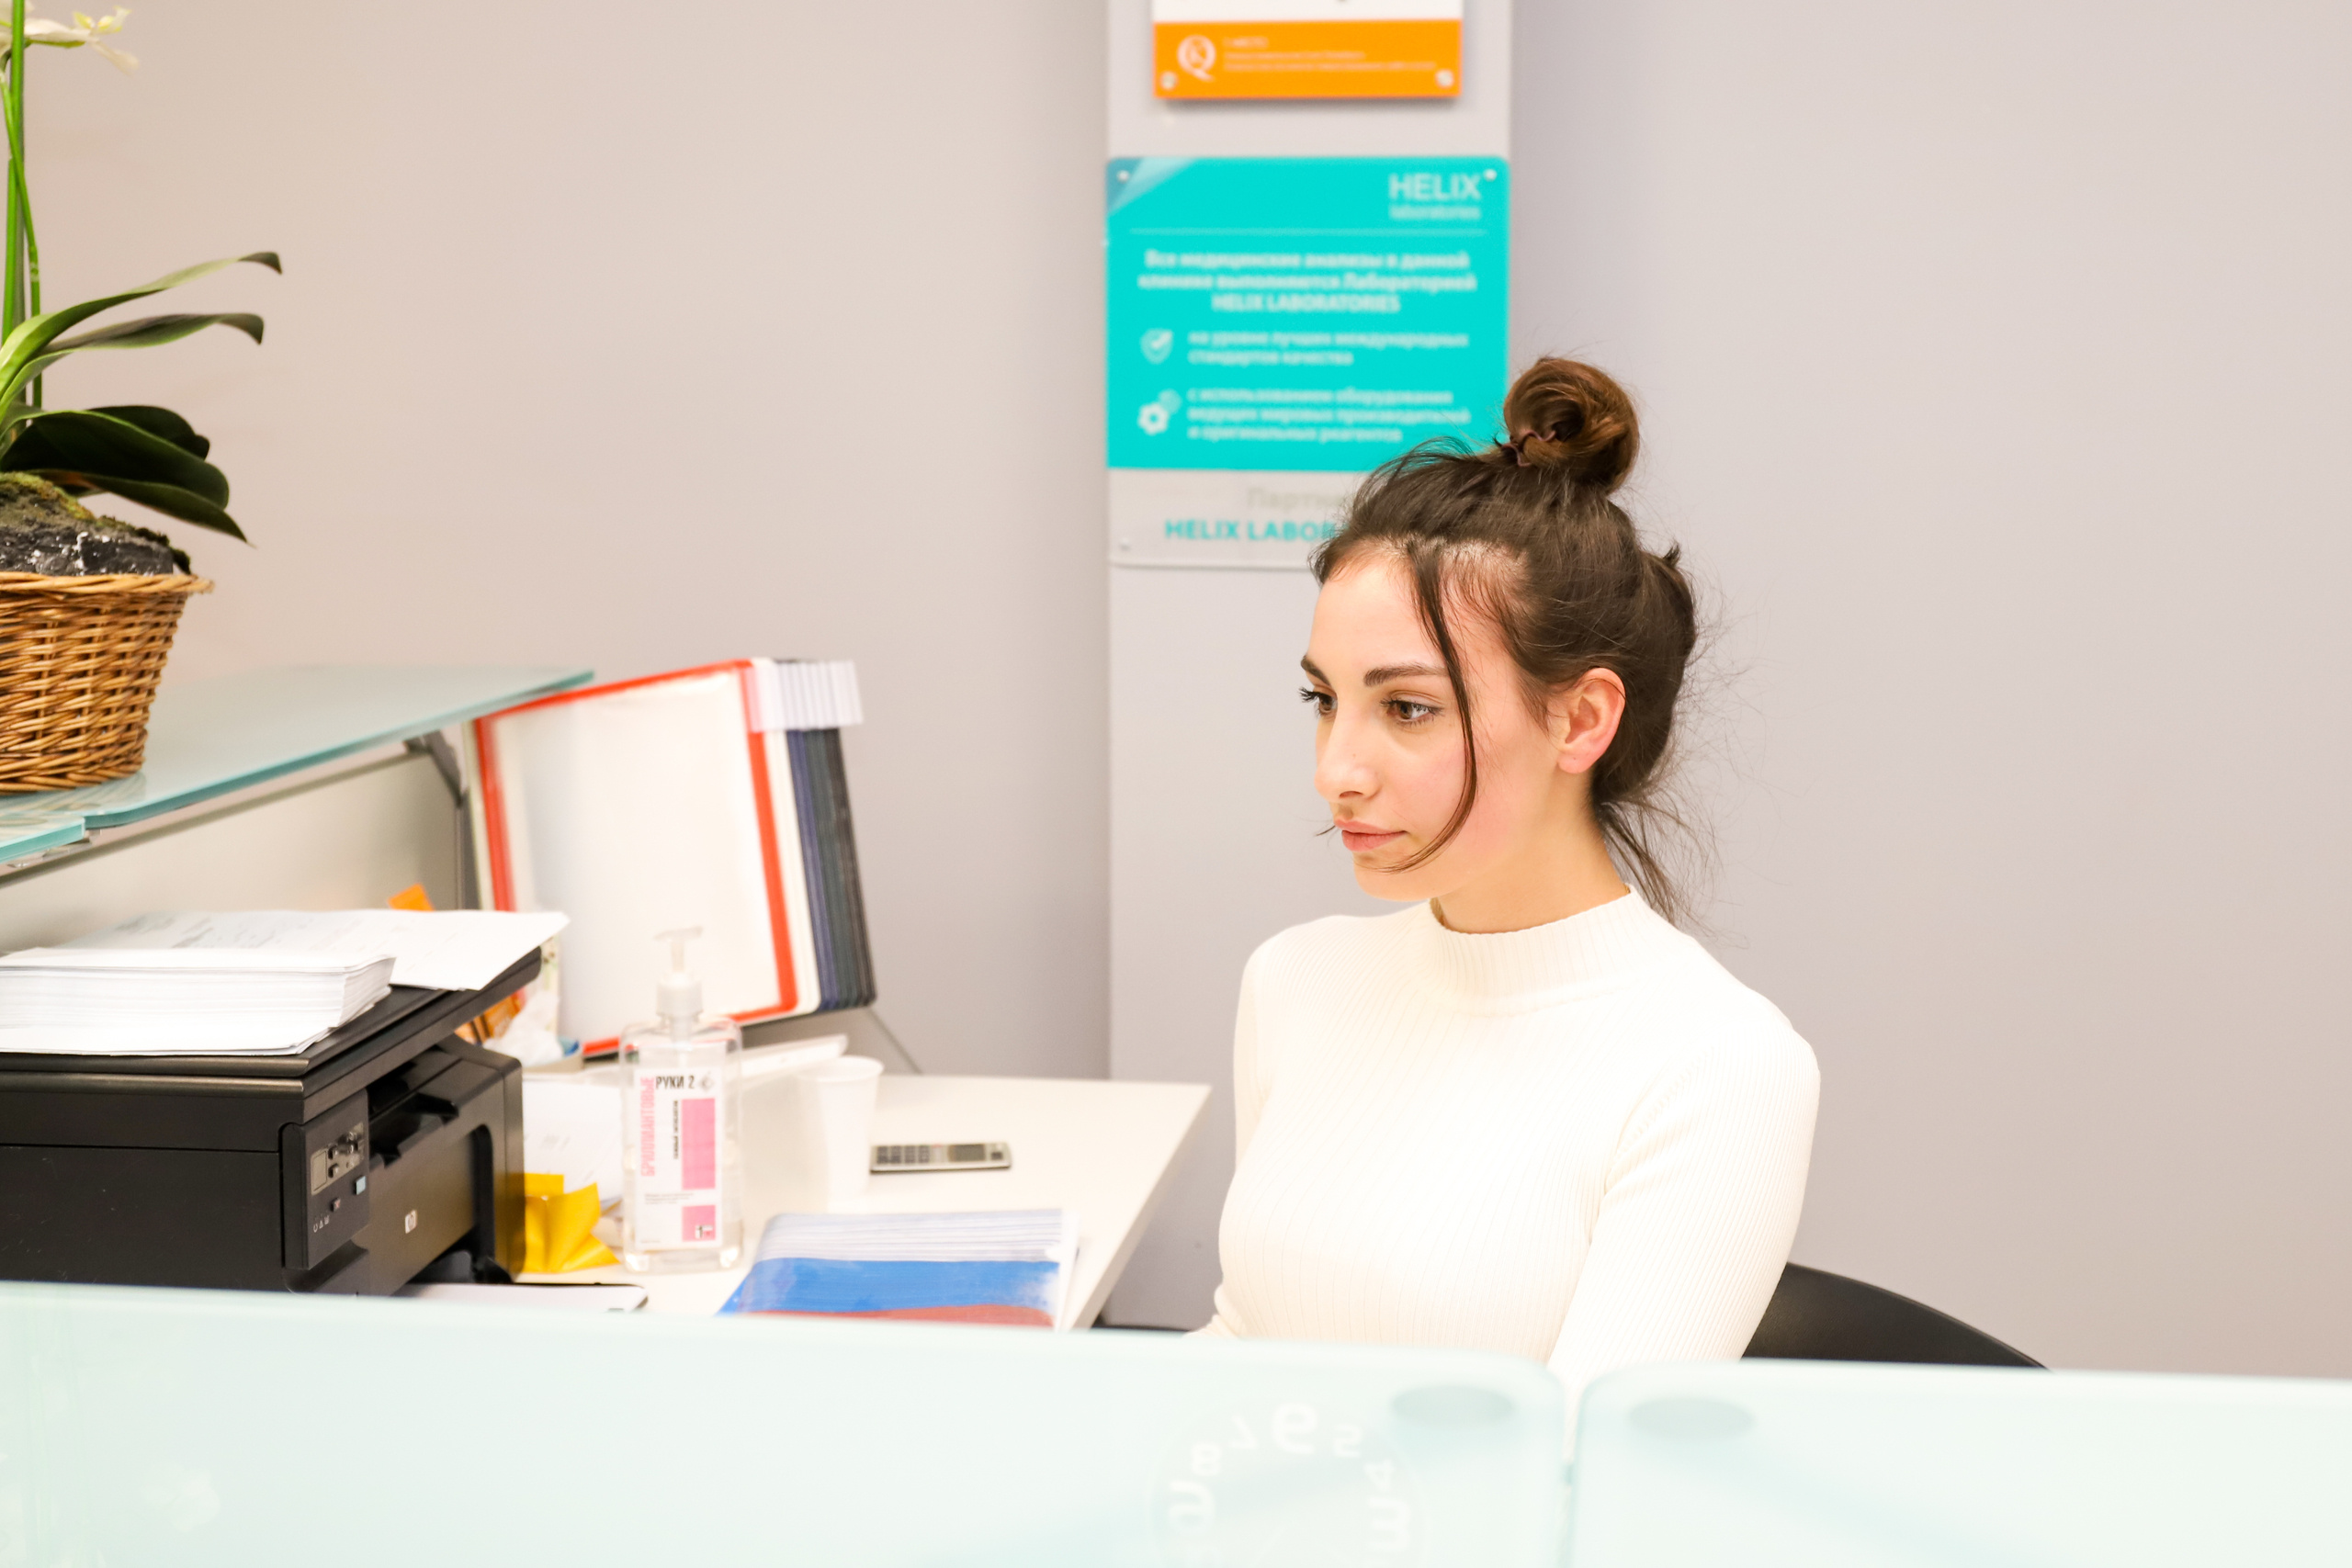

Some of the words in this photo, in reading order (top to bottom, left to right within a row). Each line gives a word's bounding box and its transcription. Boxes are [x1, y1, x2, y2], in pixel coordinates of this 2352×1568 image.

[1388, 173, 1480, 200] HELIX
[1145, 249, 1175, 267] Все
[1401, 250, 1470, 269] данной
[1212, 294, 1263, 311] HELIX
[1267, 294, 1400, 312] LABORATORIES
[1165, 519, 1238, 540] HELIX
[1248, 520, 1349, 541] LABOR
[656, 1076, 684, 1090] РУКИ
[688, 1075, 695, 1089] 2
[640, 1077, 655, 1177] БРИЛЛИАНТОВЫЕ
